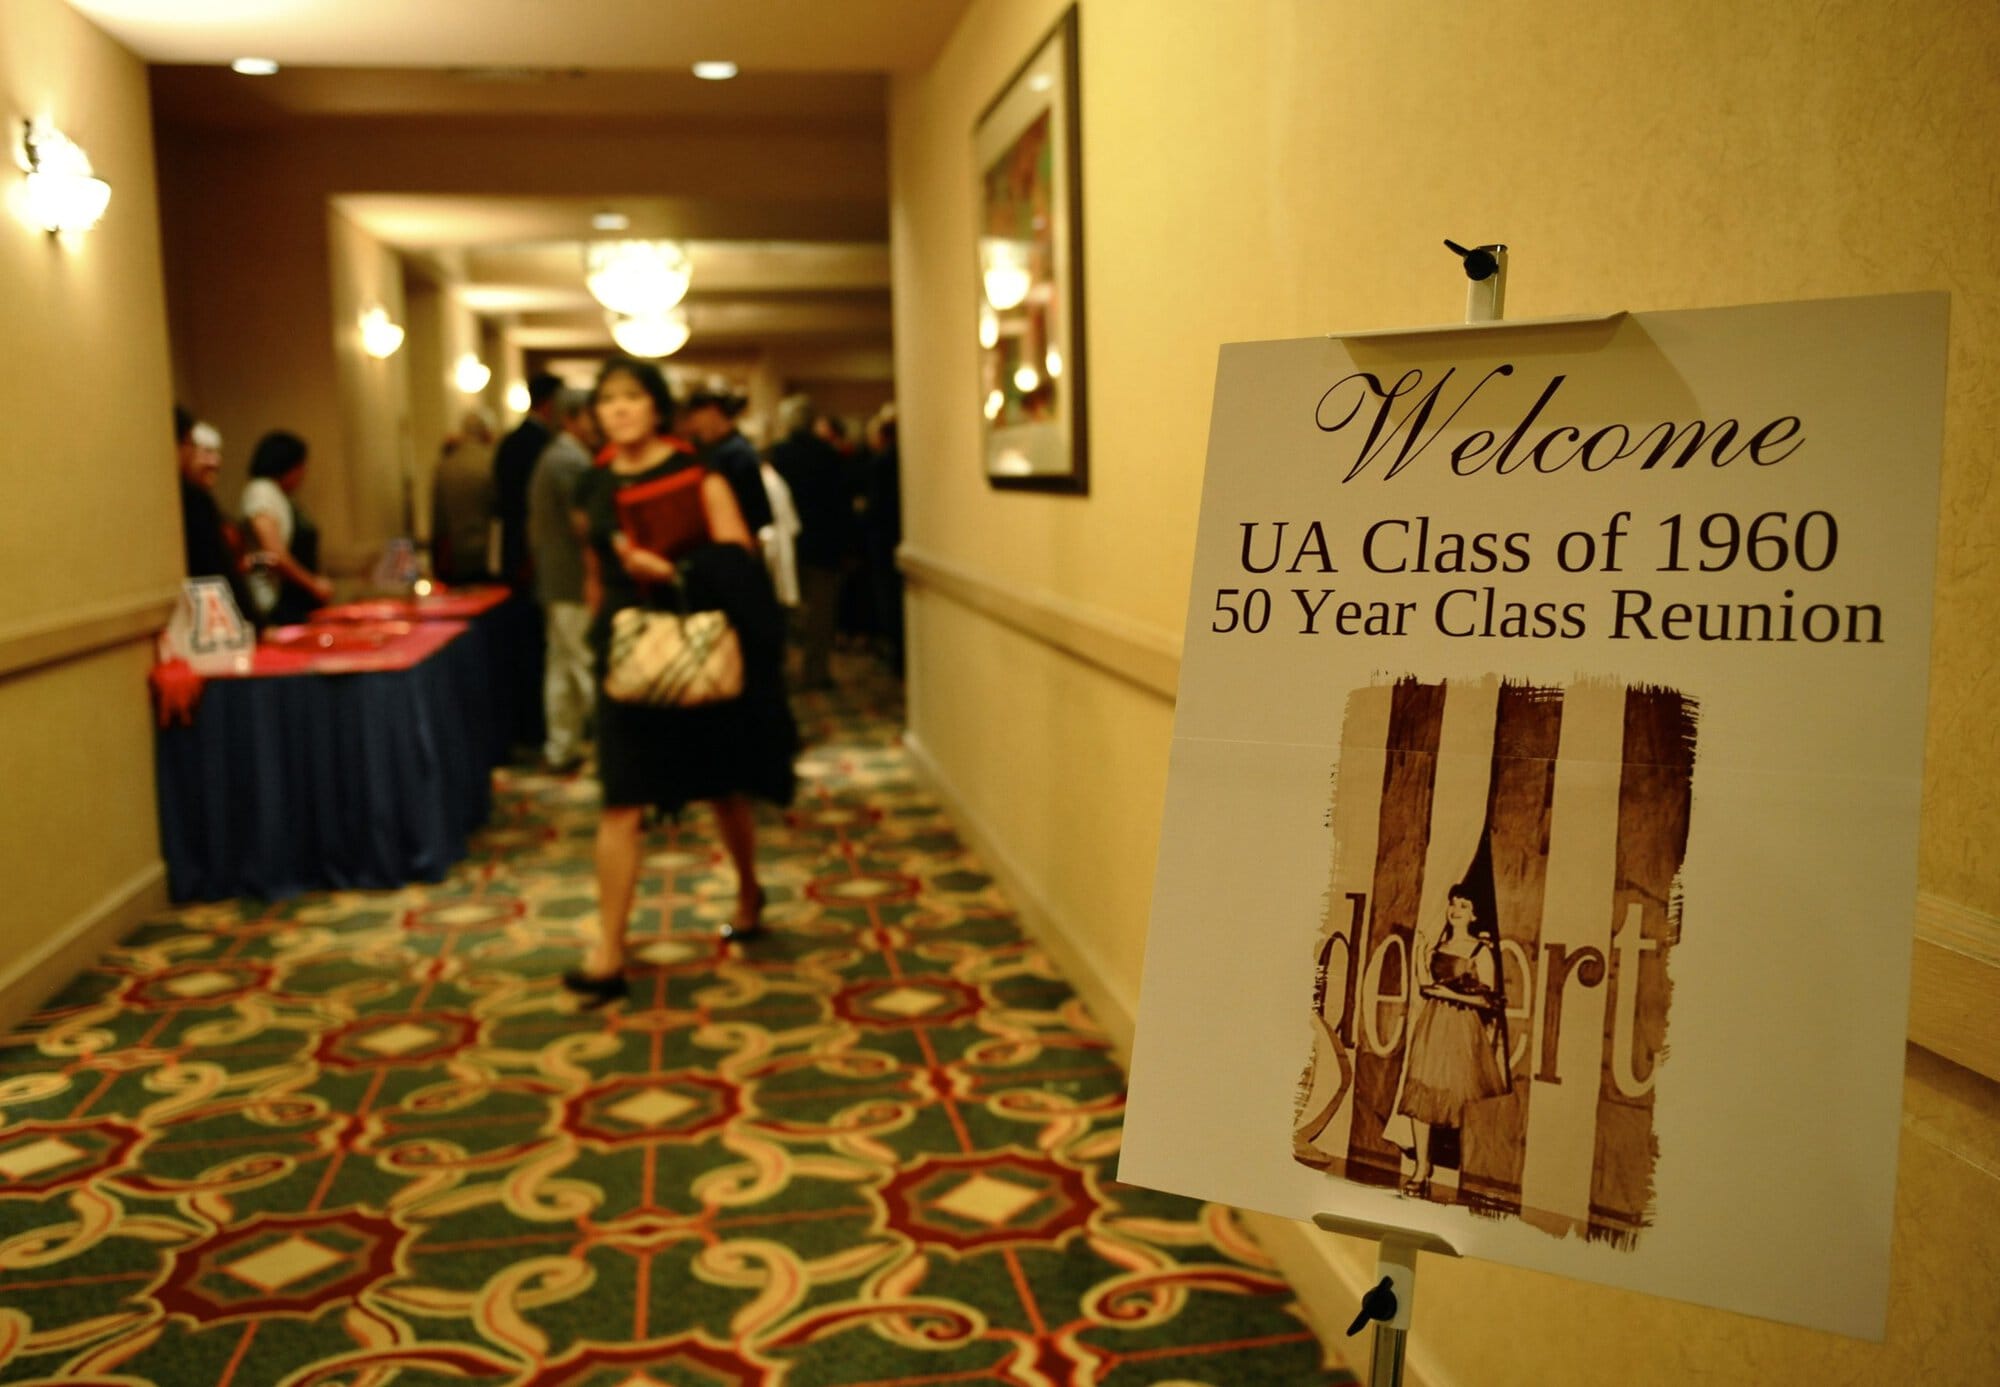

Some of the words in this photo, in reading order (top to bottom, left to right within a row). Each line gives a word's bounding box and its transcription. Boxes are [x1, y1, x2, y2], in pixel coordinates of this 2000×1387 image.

[1315, 364, 1807, 484] Welcome
[1239, 519, 1339, 575] UA
[1362, 516, 1530, 575] Class
[1557, 511, 1632, 574] of
[1656, 510, 1839, 573] 1960
[1211, 588, 1271, 635] 50
[1290, 588, 1417, 637] Year
[1435, 587, 1587, 640] Class
[1607, 588, 1885, 644] Reunion
[1313, 892, 1657, 1098] deert
